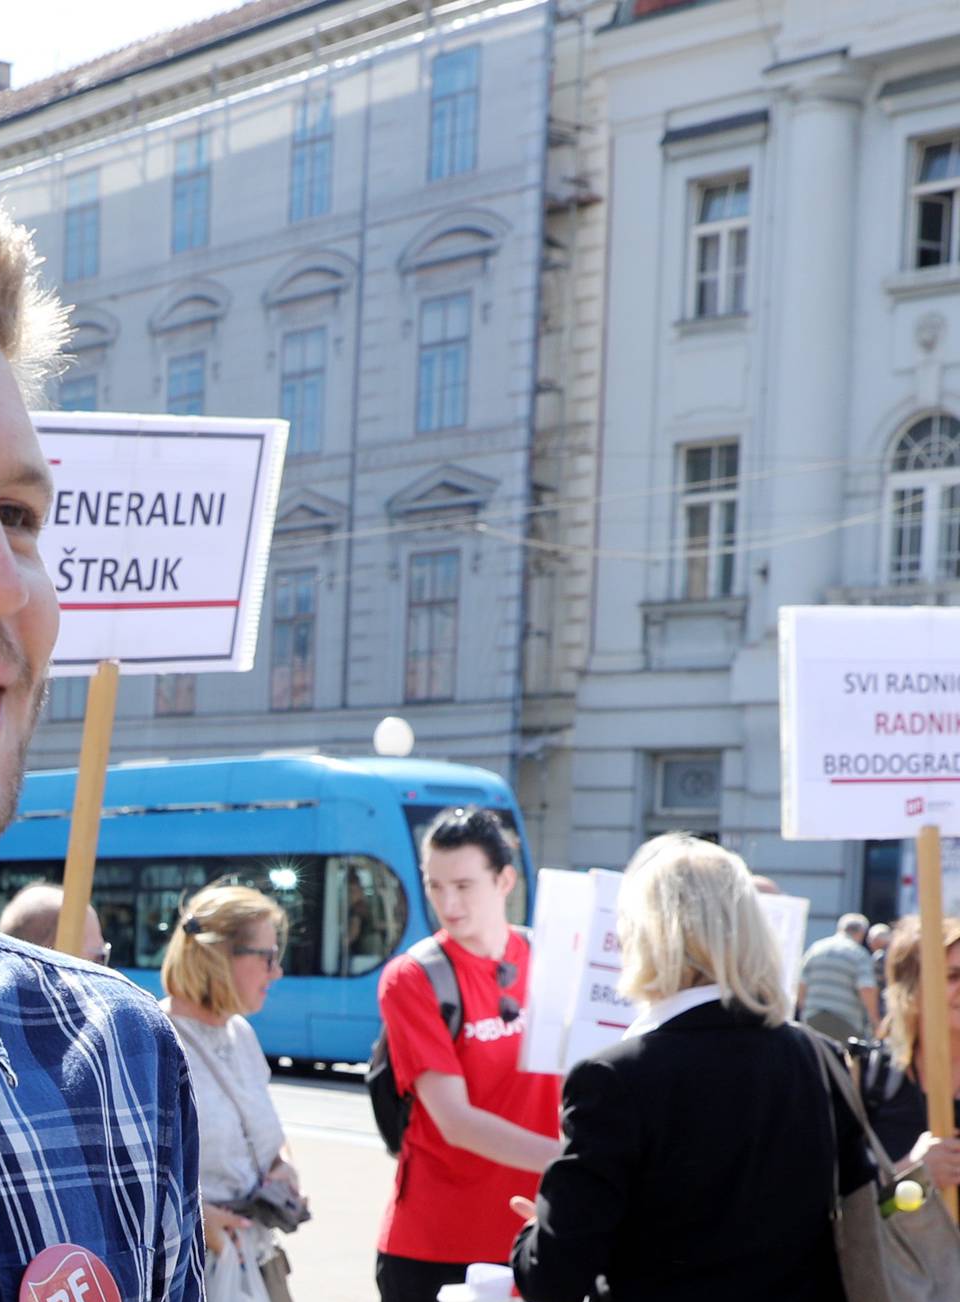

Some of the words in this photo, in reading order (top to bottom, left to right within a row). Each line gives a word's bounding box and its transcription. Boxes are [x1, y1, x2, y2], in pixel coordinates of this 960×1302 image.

[55, 546, 183, 592] ŠTRAJK
[844, 672, 879, 695] SVI
[886, 672, 960, 695] RADNI
